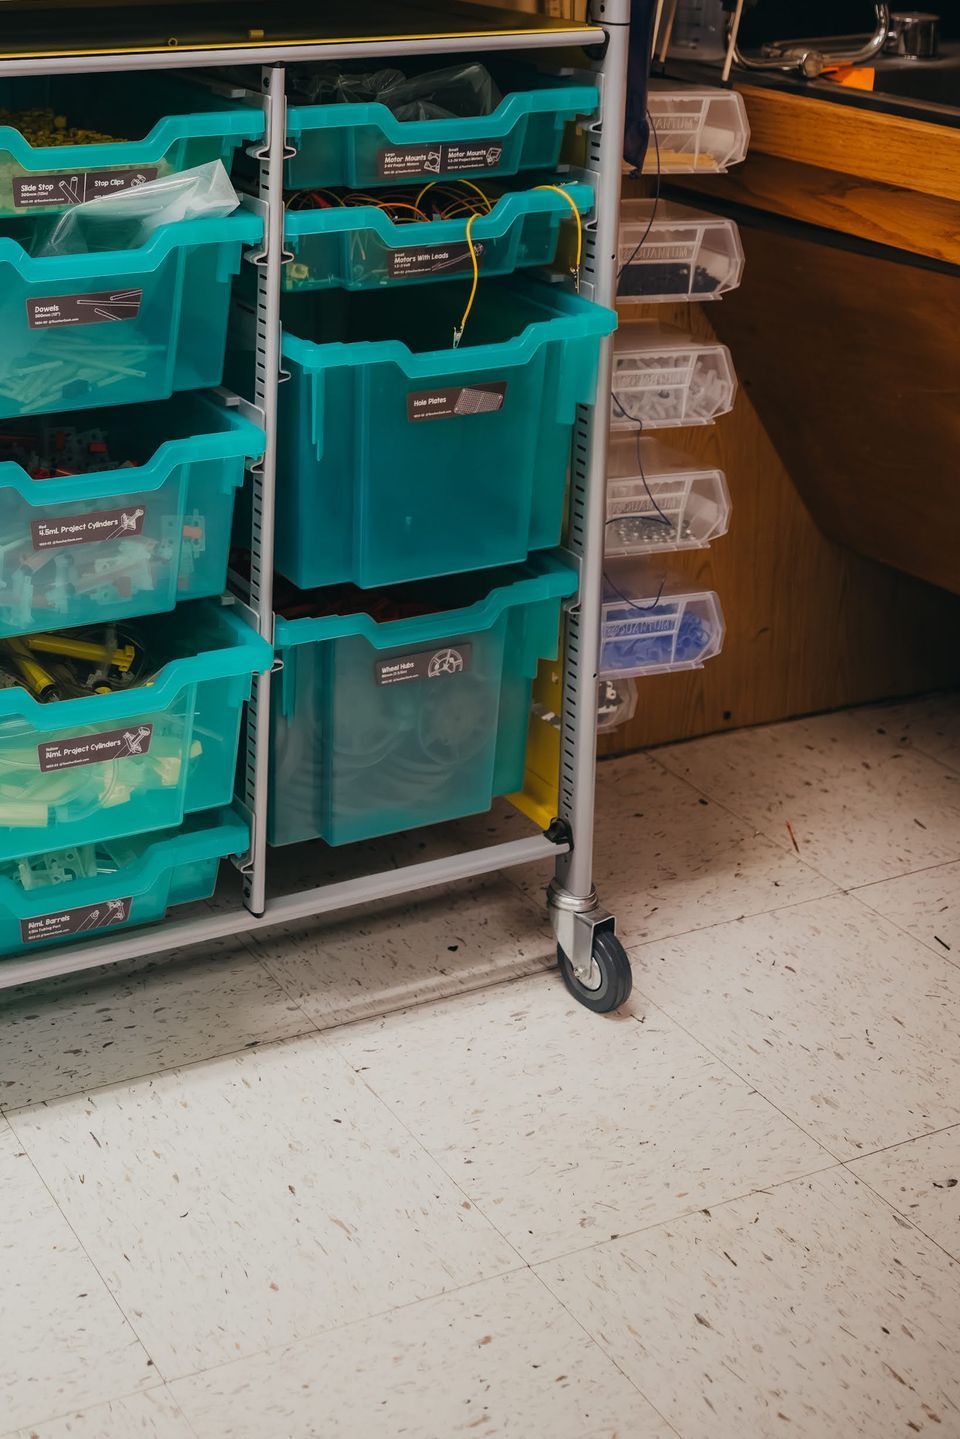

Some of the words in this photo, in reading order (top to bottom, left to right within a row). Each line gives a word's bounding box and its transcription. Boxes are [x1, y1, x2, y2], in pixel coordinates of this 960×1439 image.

[384, 156, 403, 164] Motor
[405, 154, 426, 162] Mounts
[110, 179, 125, 187] Clips
[38, 184, 54, 192] Stop
[394, 256, 416, 264] Motors
[35, 305, 59, 313] Dowels
[428, 397, 447, 405] Plates
[39, 528, 59, 536] 4.5mL
[61, 524, 86, 534] Project
[88, 519, 118, 530] Cylinders
[382, 665, 399, 673] Wheel
[400, 662, 415, 670] Hubs
[63, 745, 89, 755] Project
[90, 739, 121, 751] Cylinders
[46, 915, 70, 925] Barrels
